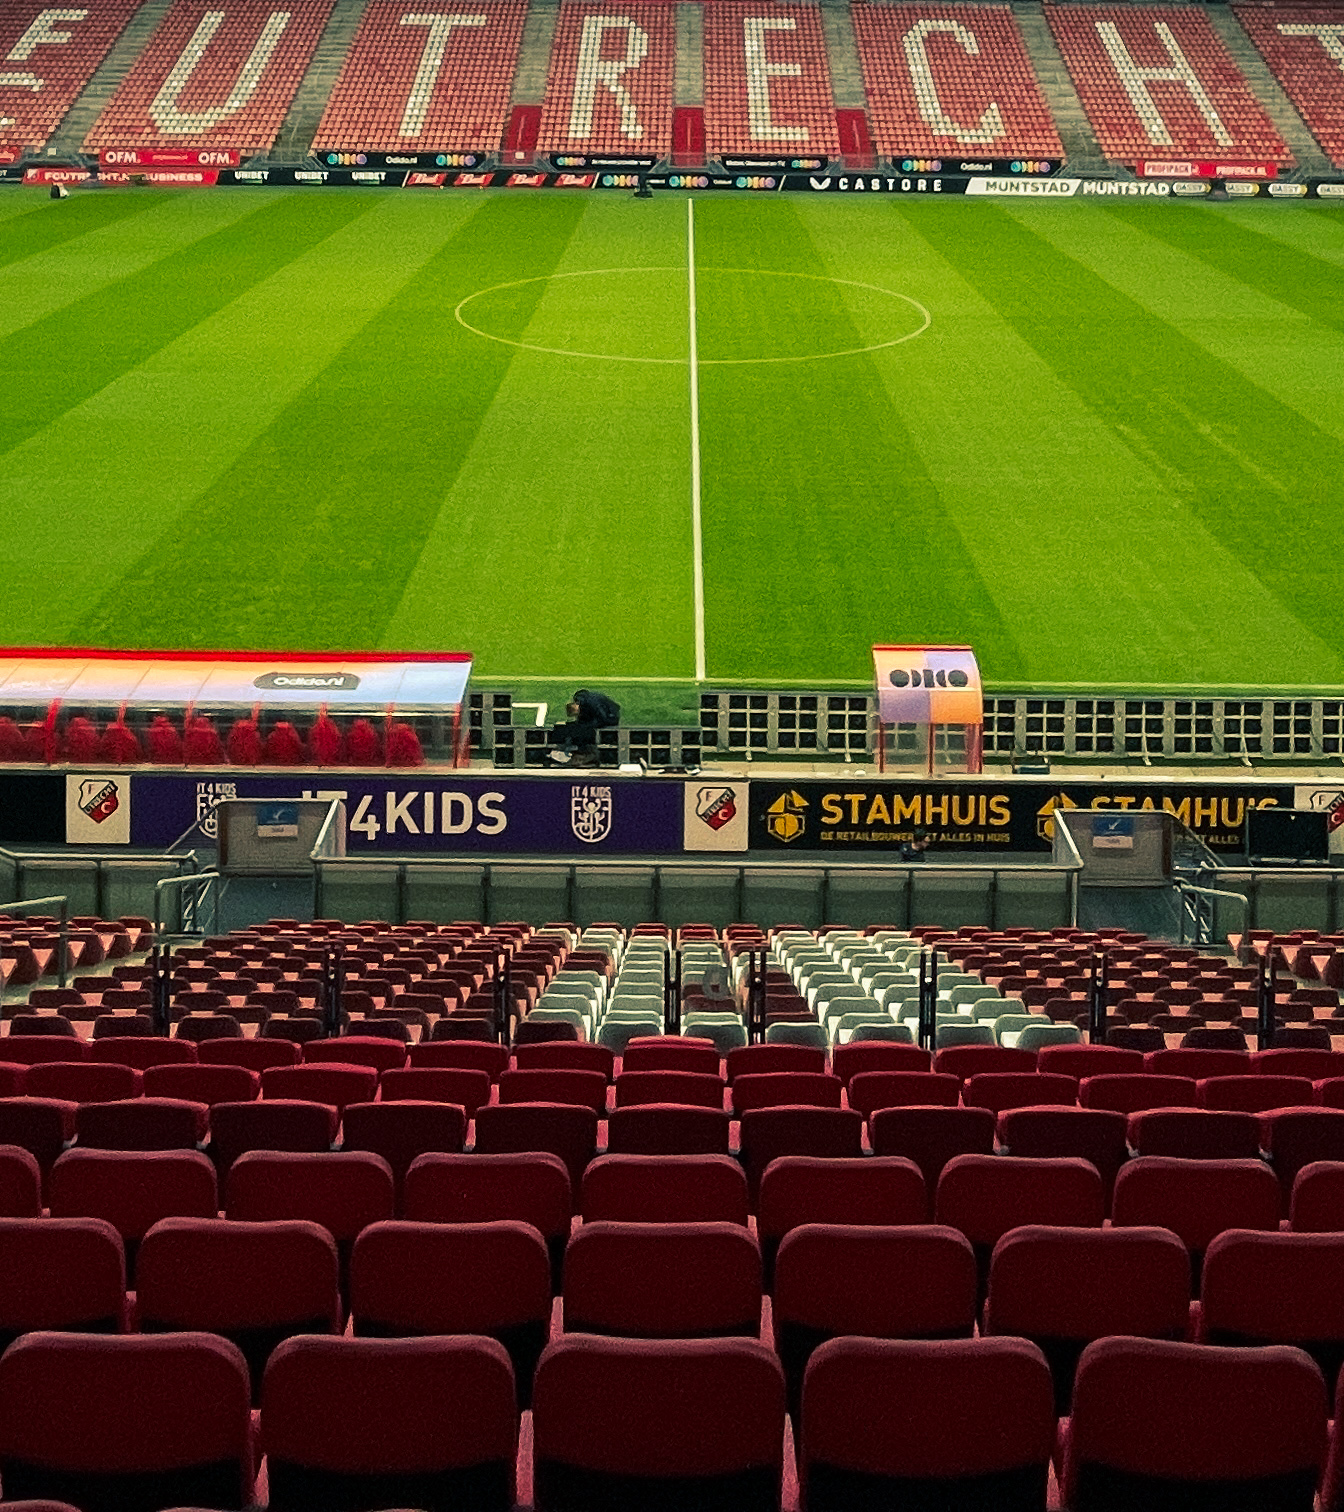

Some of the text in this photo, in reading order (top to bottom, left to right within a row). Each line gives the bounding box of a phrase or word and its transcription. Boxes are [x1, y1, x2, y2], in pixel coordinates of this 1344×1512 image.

[959, 161, 993, 172] Odido.nl
[838, 177, 943, 192] CASTORE
[985, 180, 1071, 194] MUNTSTAD
[1082, 180, 1170, 196] MUNTSTAD
[101, 801, 112, 814] C
[718, 808, 730, 821] C
[820, 793, 1011, 826] STAMHUIS
[302, 790, 508, 841] 4KIDS
